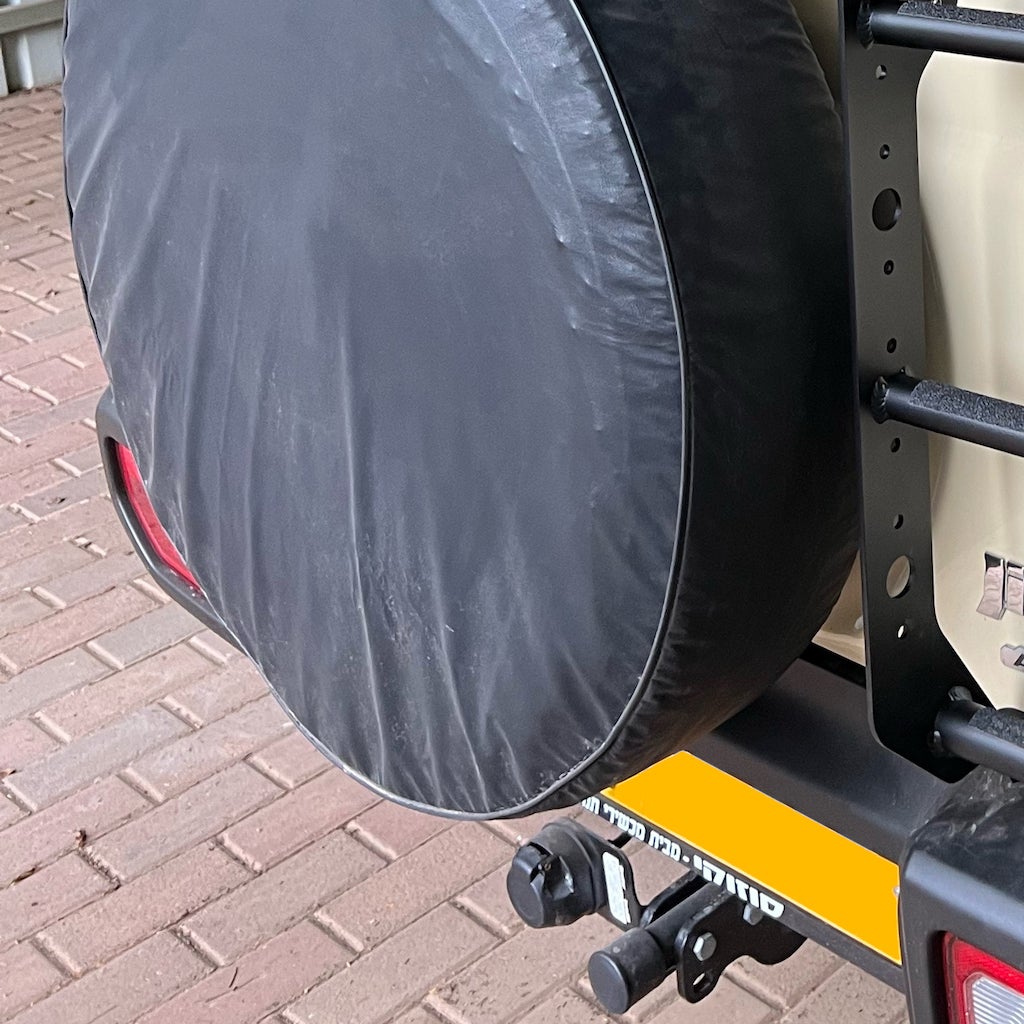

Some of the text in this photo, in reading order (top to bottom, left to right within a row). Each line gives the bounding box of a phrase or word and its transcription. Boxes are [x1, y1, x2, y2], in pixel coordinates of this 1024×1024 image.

[603, 803, 646, 841] מכשירי
[648, 830, 681, 862] מבית
[693, 854, 785, 918] סוזוקי
